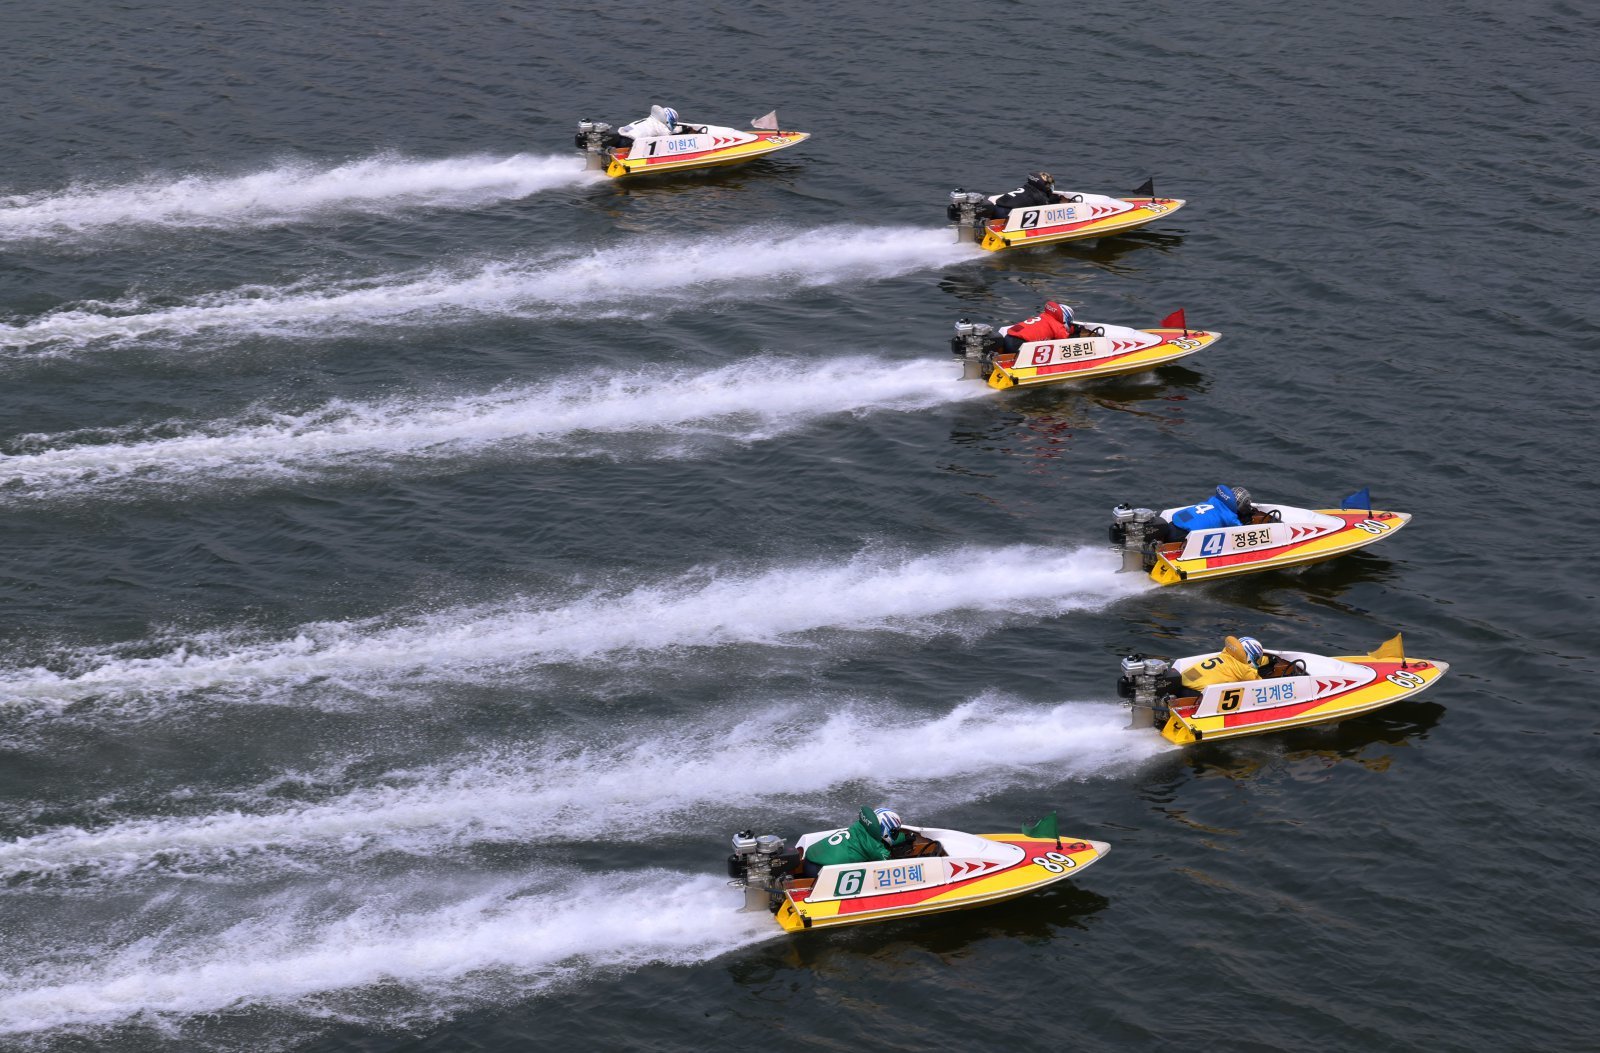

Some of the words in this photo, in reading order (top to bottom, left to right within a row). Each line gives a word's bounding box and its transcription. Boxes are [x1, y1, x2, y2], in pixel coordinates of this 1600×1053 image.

[648, 142, 656, 155] 1
[668, 138, 696, 151] 이현지
[1008, 188, 1025, 198] 2
[1023, 211, 1037, 228] 2
[1047, 208, 1075, 221] 이지은
[1024, 316, 1042, 325] 3
[1061, 341, 1093, 358] 정훈민
[1166, 336, 1202, 349] 35
[1035, 346, 1051, 364] 3
[1195, 504, 1215, 515] 4
[1353, 519, 1390, 534] 80
[1204, 535, 1220, 555] 4
[1234, 530, 1270, 547] 정용진
[1200, 657, 1224, 670] 5
[1386, 670, 1425, 688] 69
[1222, 690, 1241, 711] 5
[1255, 683, 1295, 703] 김계영
[828, 829, 850, 846] 6
[1032, 852, 1076, 873] 89
[838, 871, 860, 894] 6
[877, 865, 923, 886] 김인혜
